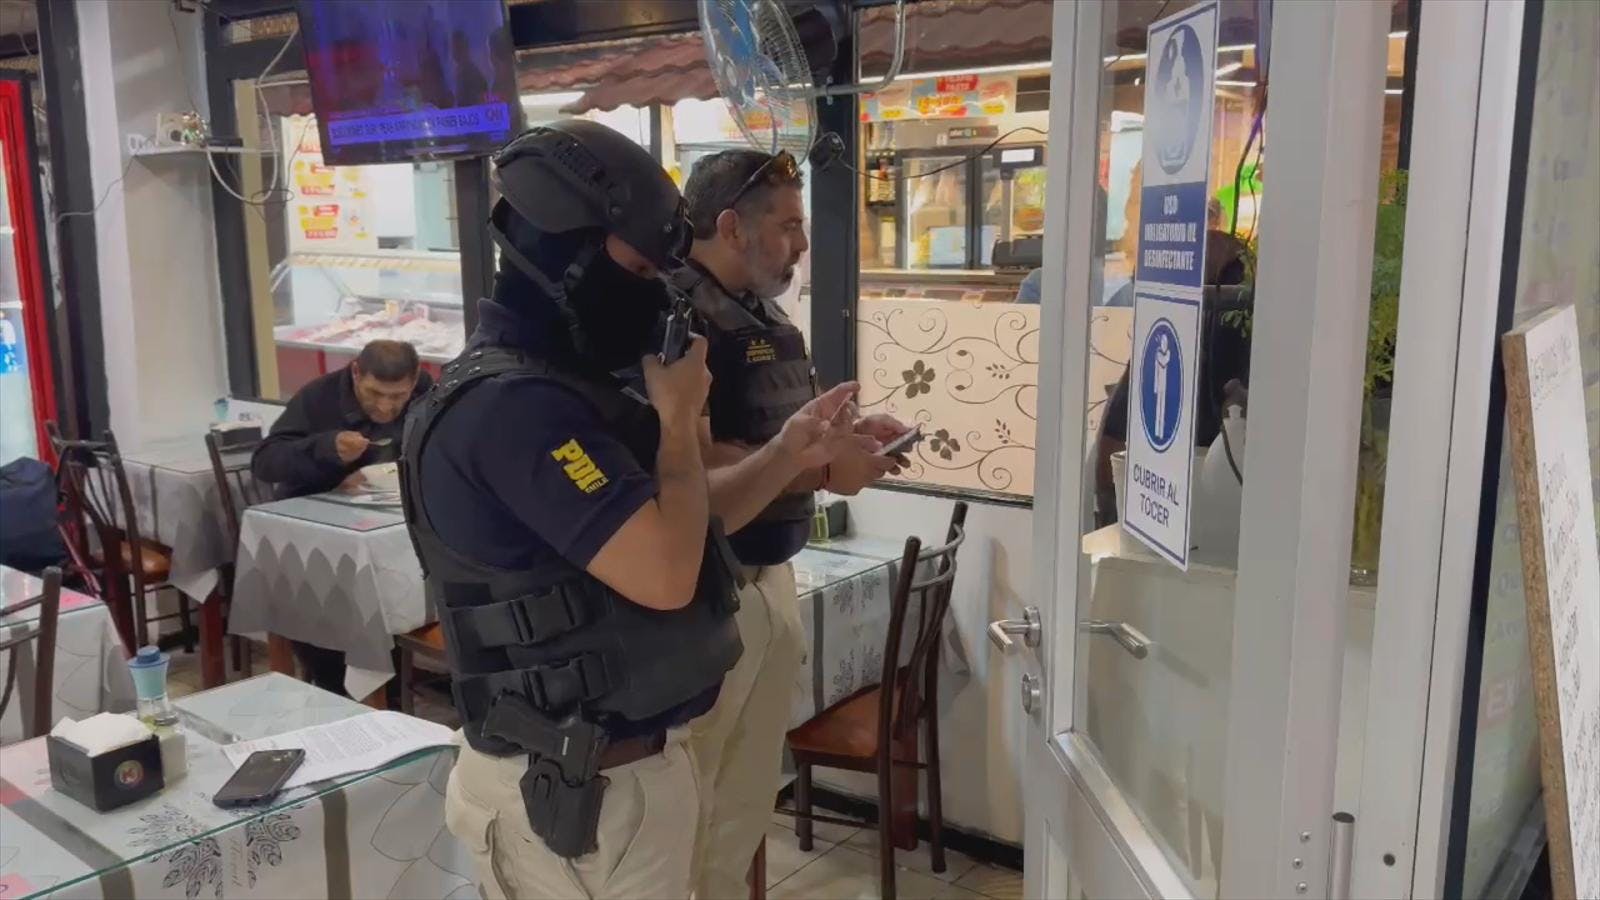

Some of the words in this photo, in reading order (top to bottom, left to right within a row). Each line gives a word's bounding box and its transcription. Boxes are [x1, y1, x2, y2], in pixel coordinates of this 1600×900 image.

[1163, 195, 1179, 215] USO
[1144, 223, 1186, 242] OBLIGATORIO
[1144, 249, 1194, 271] DESINFECTANTE
[551, 439, 604, 490] PDI
[1133, 463, 1165, 496] CUBRIR
[1168, 482, 1179, 504] AL
[1140, 493, 1169, 527] TOCER
